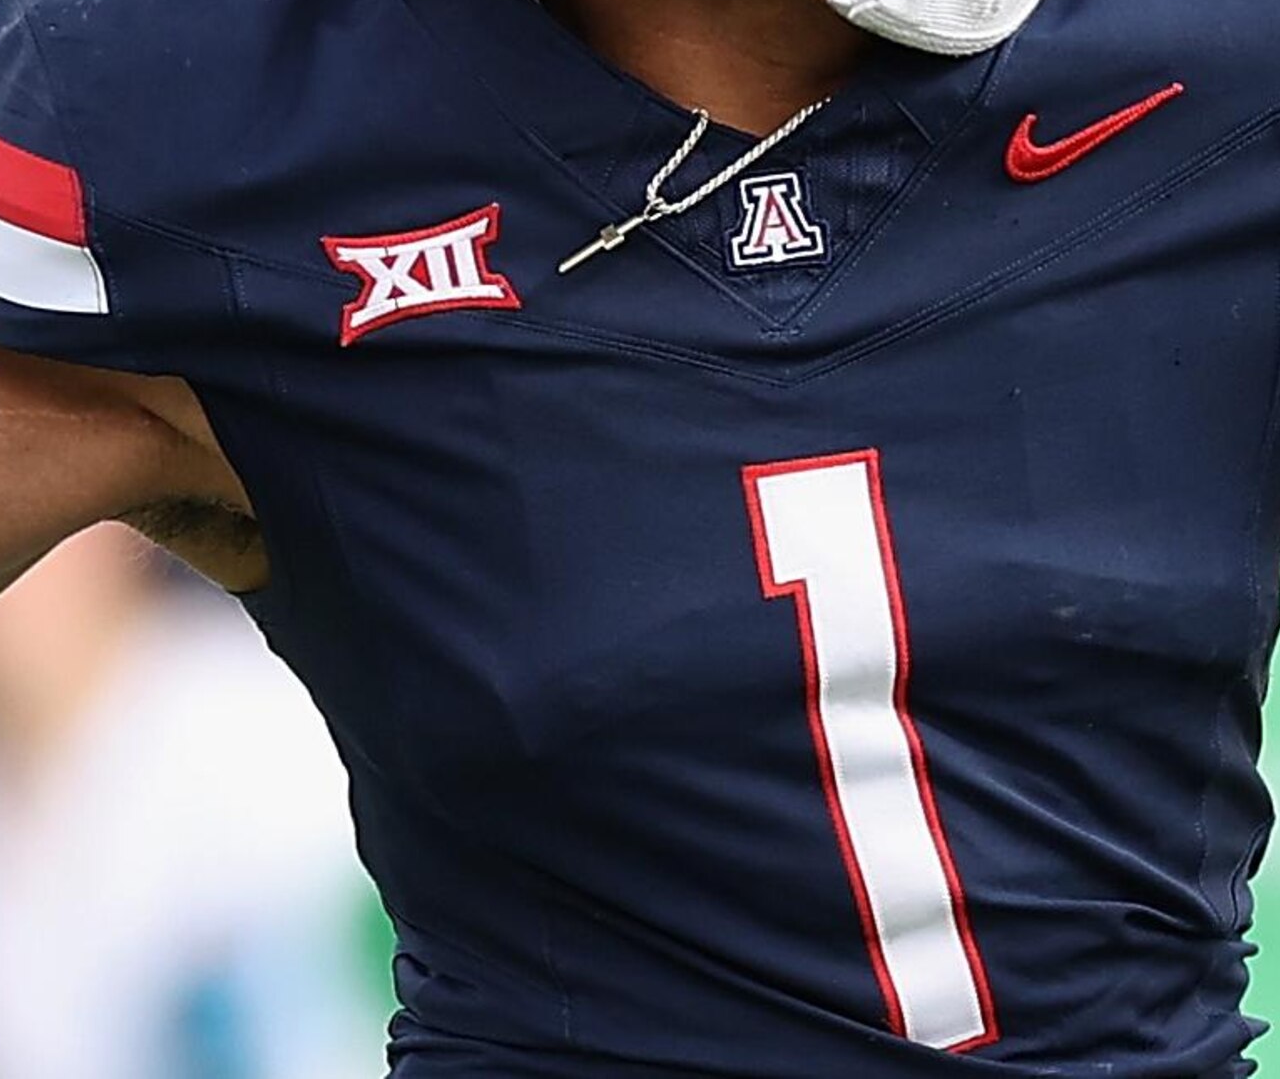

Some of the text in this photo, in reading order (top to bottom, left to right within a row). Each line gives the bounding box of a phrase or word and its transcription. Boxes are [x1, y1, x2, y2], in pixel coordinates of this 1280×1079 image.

[334, 215, 507, 330] XII
[731, 172, 824, 265] A
[741, 447, 1002, 1053] 1
